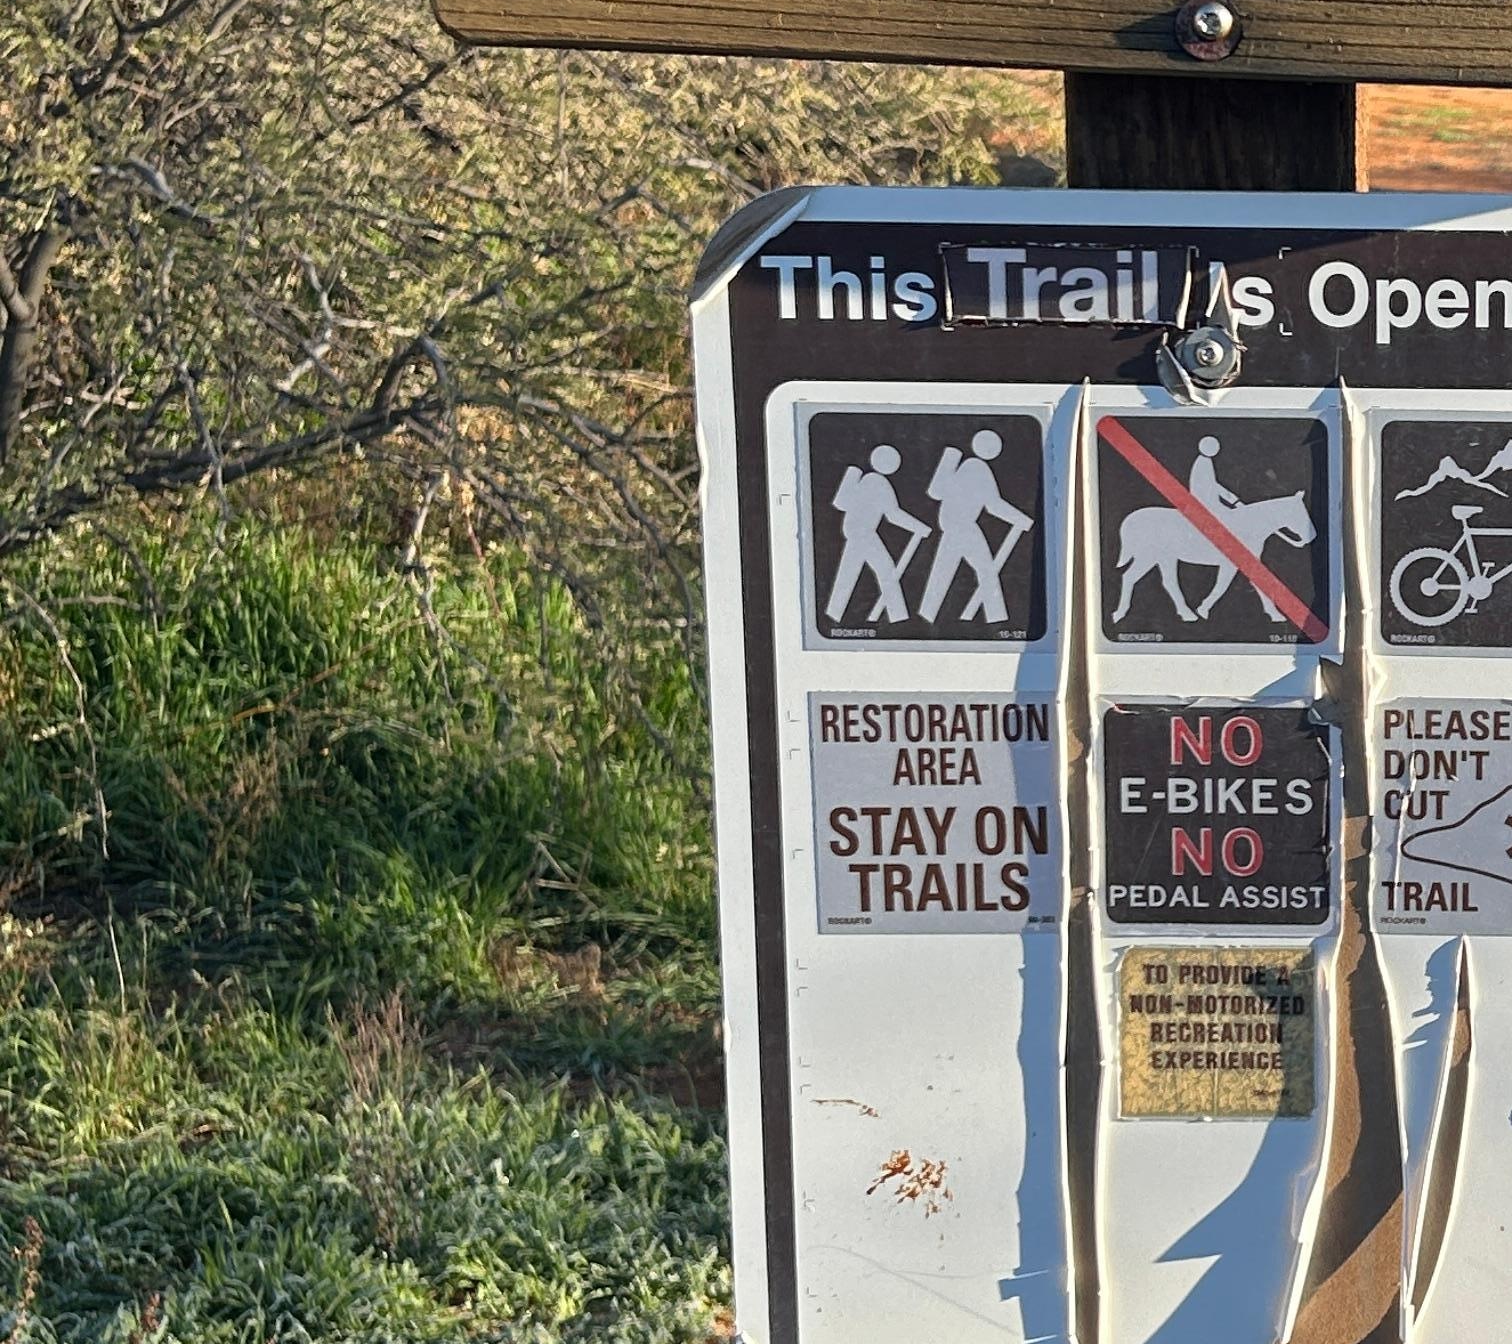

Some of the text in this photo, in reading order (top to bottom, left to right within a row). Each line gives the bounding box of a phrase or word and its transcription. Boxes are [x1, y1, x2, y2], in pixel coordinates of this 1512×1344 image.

[760, 256, 937, 323] This
[966, 248, 1158, 323] Trail
[820, 703, 1049, 743] RESTORATION
[1384, 709, 1511, 741] PLEASE
[1170, 716, 1263, 766] NO
[893, 747, 982, 786] AREA
[1384, 749, 1490, 781] DON'T
[1120, 777, 1313, 815] E-BIKES
[1384, 790, 1449, 821] CUT
[829, 806, 1048, 856] STAY ON
[1171, 827, 1264, 877] NO
[849, 862, 1030, 912] TRAILS
[1109, 885, 1325, 909] PEDAL ASSIST
[1382, 881, 1478, 912] TRAIL
[1143, 964, 1291, 985] TO PROVIDE A
[1130, 994, 1305, 1015] NON-MOTORIZED
[1151, 1022, 1283, 1044] RECREATION
[1151, 1051, 1283, 1071] EXPERIENCE
